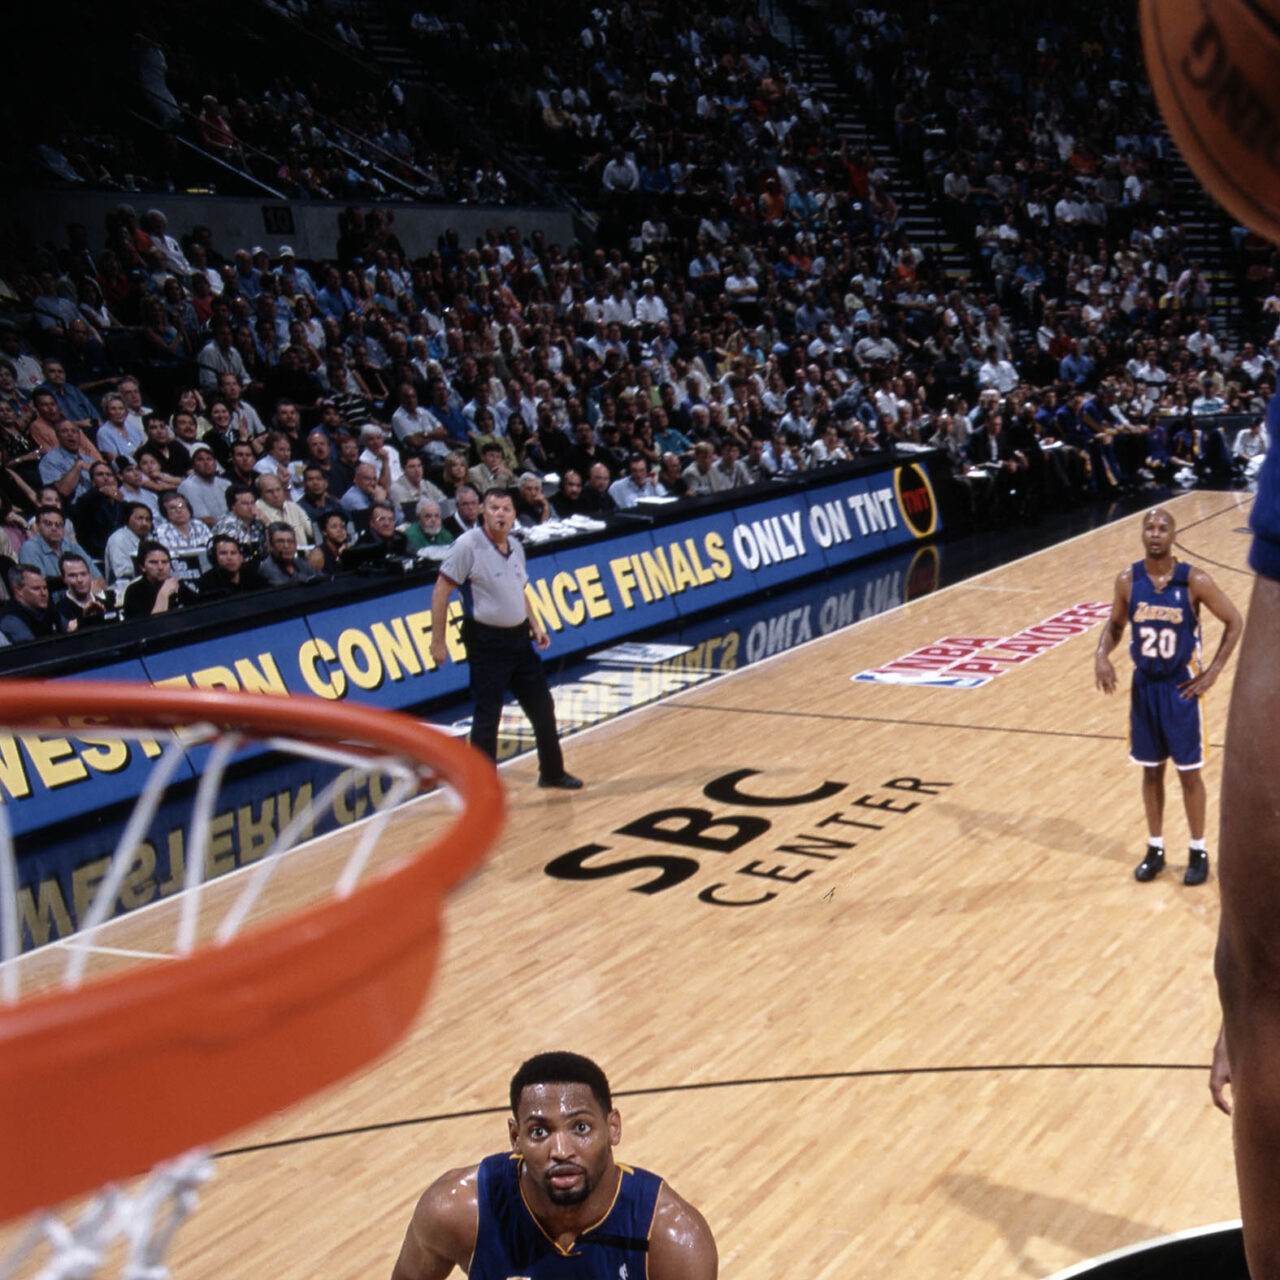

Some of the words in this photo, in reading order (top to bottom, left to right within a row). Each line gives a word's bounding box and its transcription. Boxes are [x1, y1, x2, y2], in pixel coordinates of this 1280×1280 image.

[299, 566, 613, 700] CONFENCE
[610, 531, 733, 611] FINALS
[733, 511, 807, 571] ONLY
[809, 503, 853, 549] ON
[847, 487, 898, 537] TNT
[943, 601, 1114, 675] PLAYOFFS
[1139, 626, 1177, 659] 20
[884, 635, 1005, 671] NBA
[543, 768, 850, 896] SBC
[697, 776, 954, 907] CENTER
